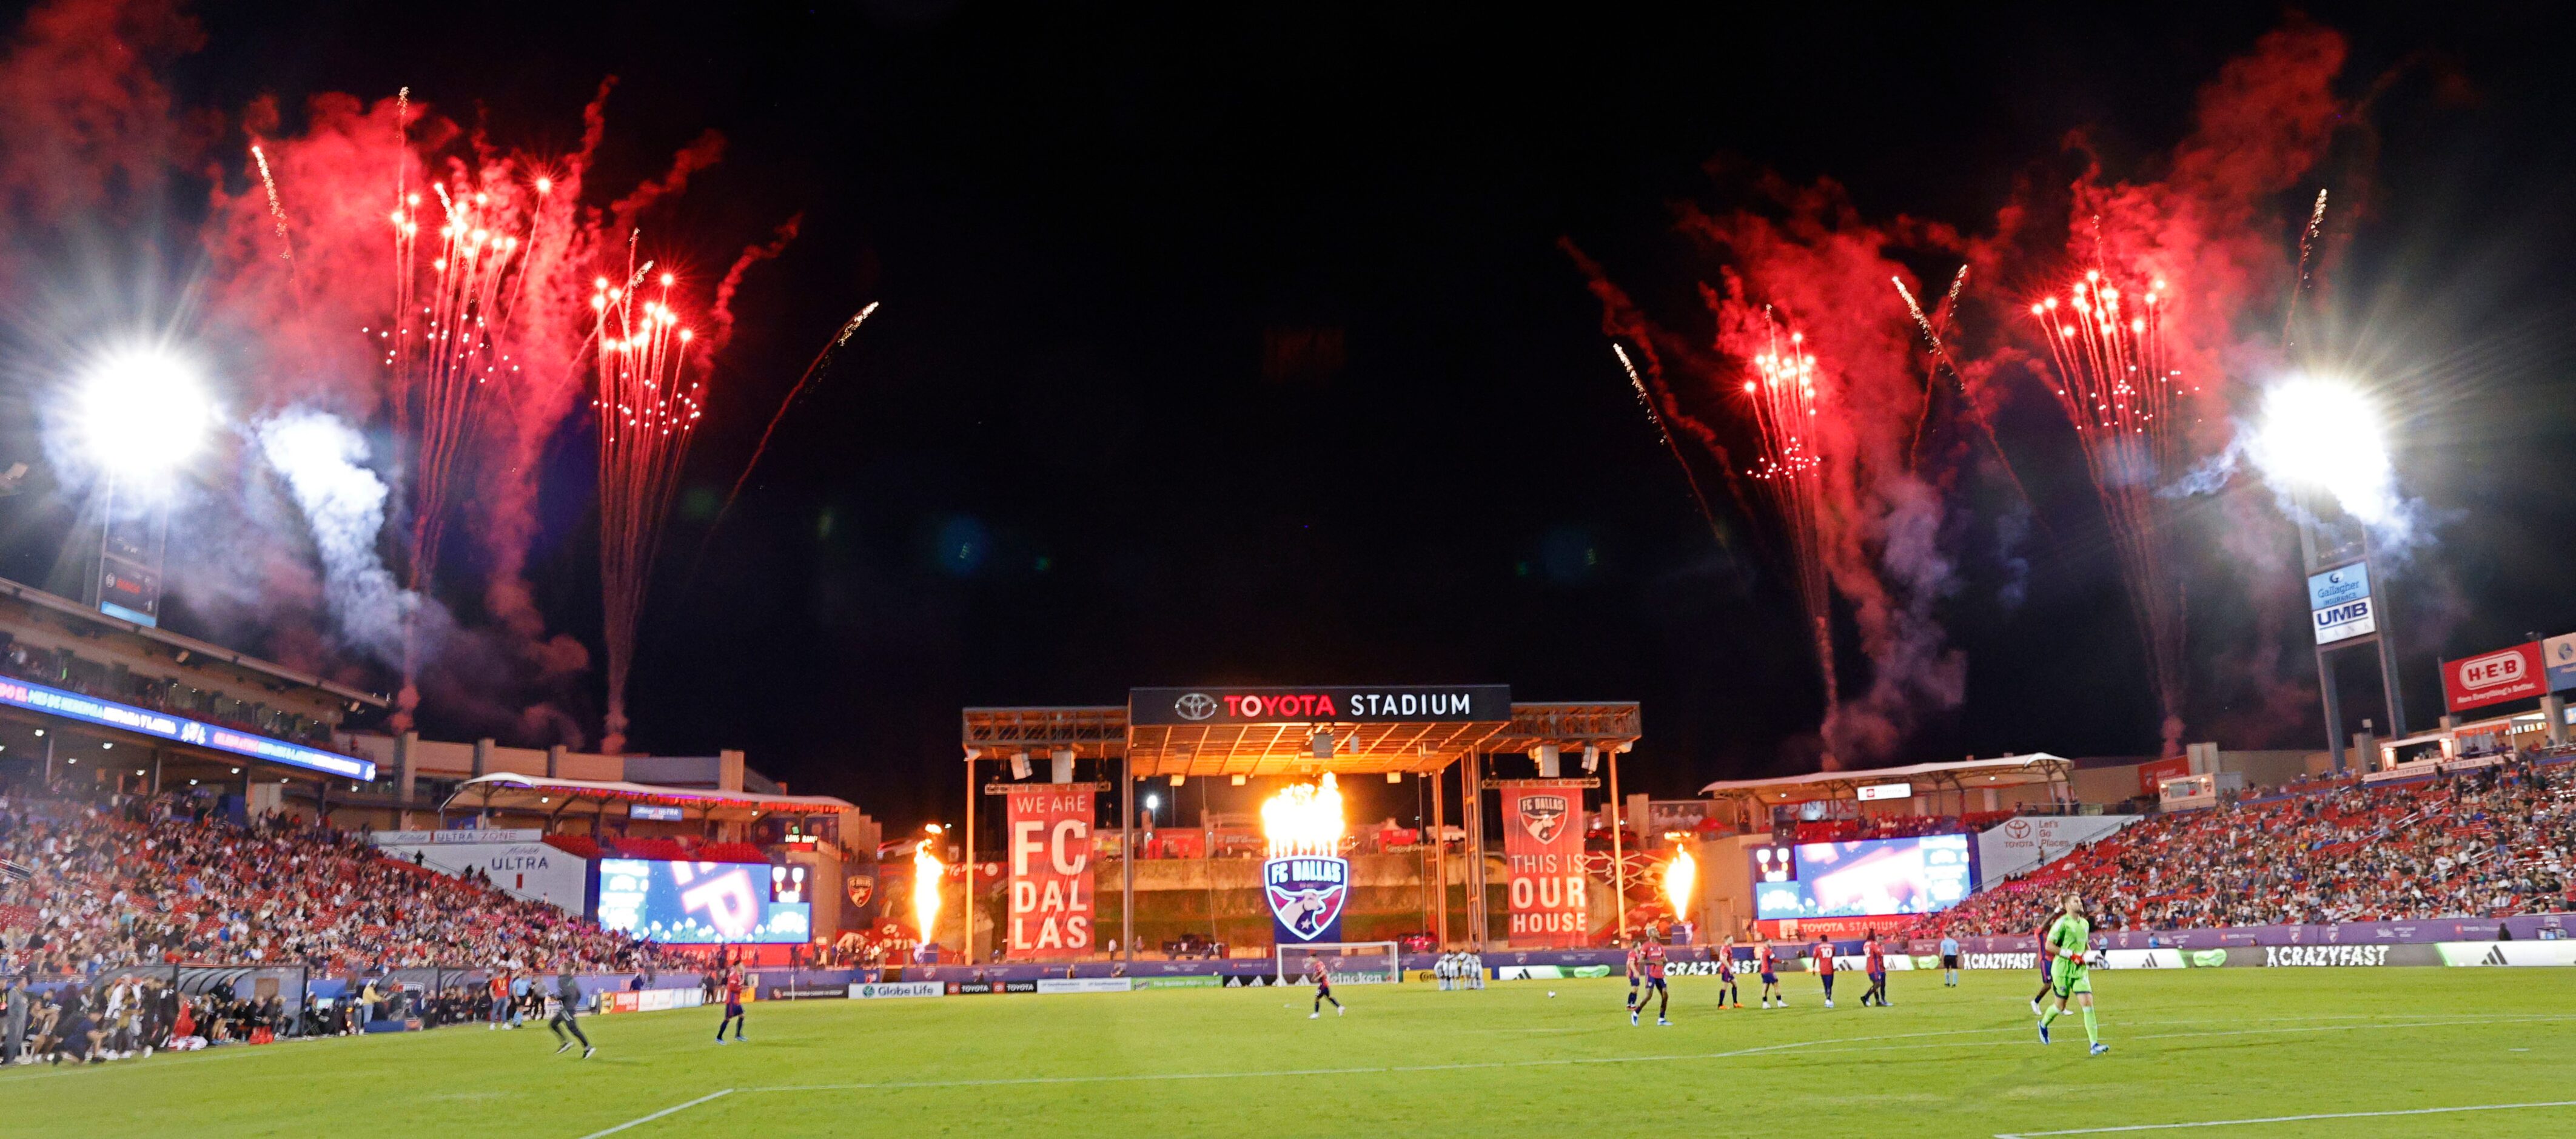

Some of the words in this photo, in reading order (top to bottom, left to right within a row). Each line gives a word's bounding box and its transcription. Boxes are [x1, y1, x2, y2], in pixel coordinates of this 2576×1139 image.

[2318, 581, 2359, 598] Gallagher
[2317, 602, 2368, 625] UMB
[1224, 694, 1336, 717] TOYOTA
[1351, 694, 1471, 716] STADIUM
[1016, 796, 1045, 813] WE
[1051, 795, 1086, 812] ARE
[1522, 799, 1532, 811] FC
[1535, 798, 1564, 810] DALLAS
[437, 832, 473, 842] ULTRA
[481, 831, 516, 841] ZONE
[1015, 819, 1087, 876] FC
[492, 857, 549, 871] ULTRA
[1271, 862, 1289, 884] FC
[1292, 860, 1341, 883] DALLAS
[1511, 854, 1557, 874] THIS
[1567, 854, 1585, 873] IS
[1015, 880, 1087, 913] DAL
[1512, 876, 1586, 909] OUR
[1015, 915, 1087, 950] LAS
[1513, 912, 1586, 933] HOUSE
[1801, 922, 1845, 933] TOYOTA
[1849, 921, 1899, 932] STADIUM
[1820, 947, 1833, 958] 10
[1971, 953, 2037, 969] CRAZYFAST
[2279, 945, 2390, 966] CRAZYFAST
[878, 986, 910, 996] Globe
[913, 984, 934, 995] Life
